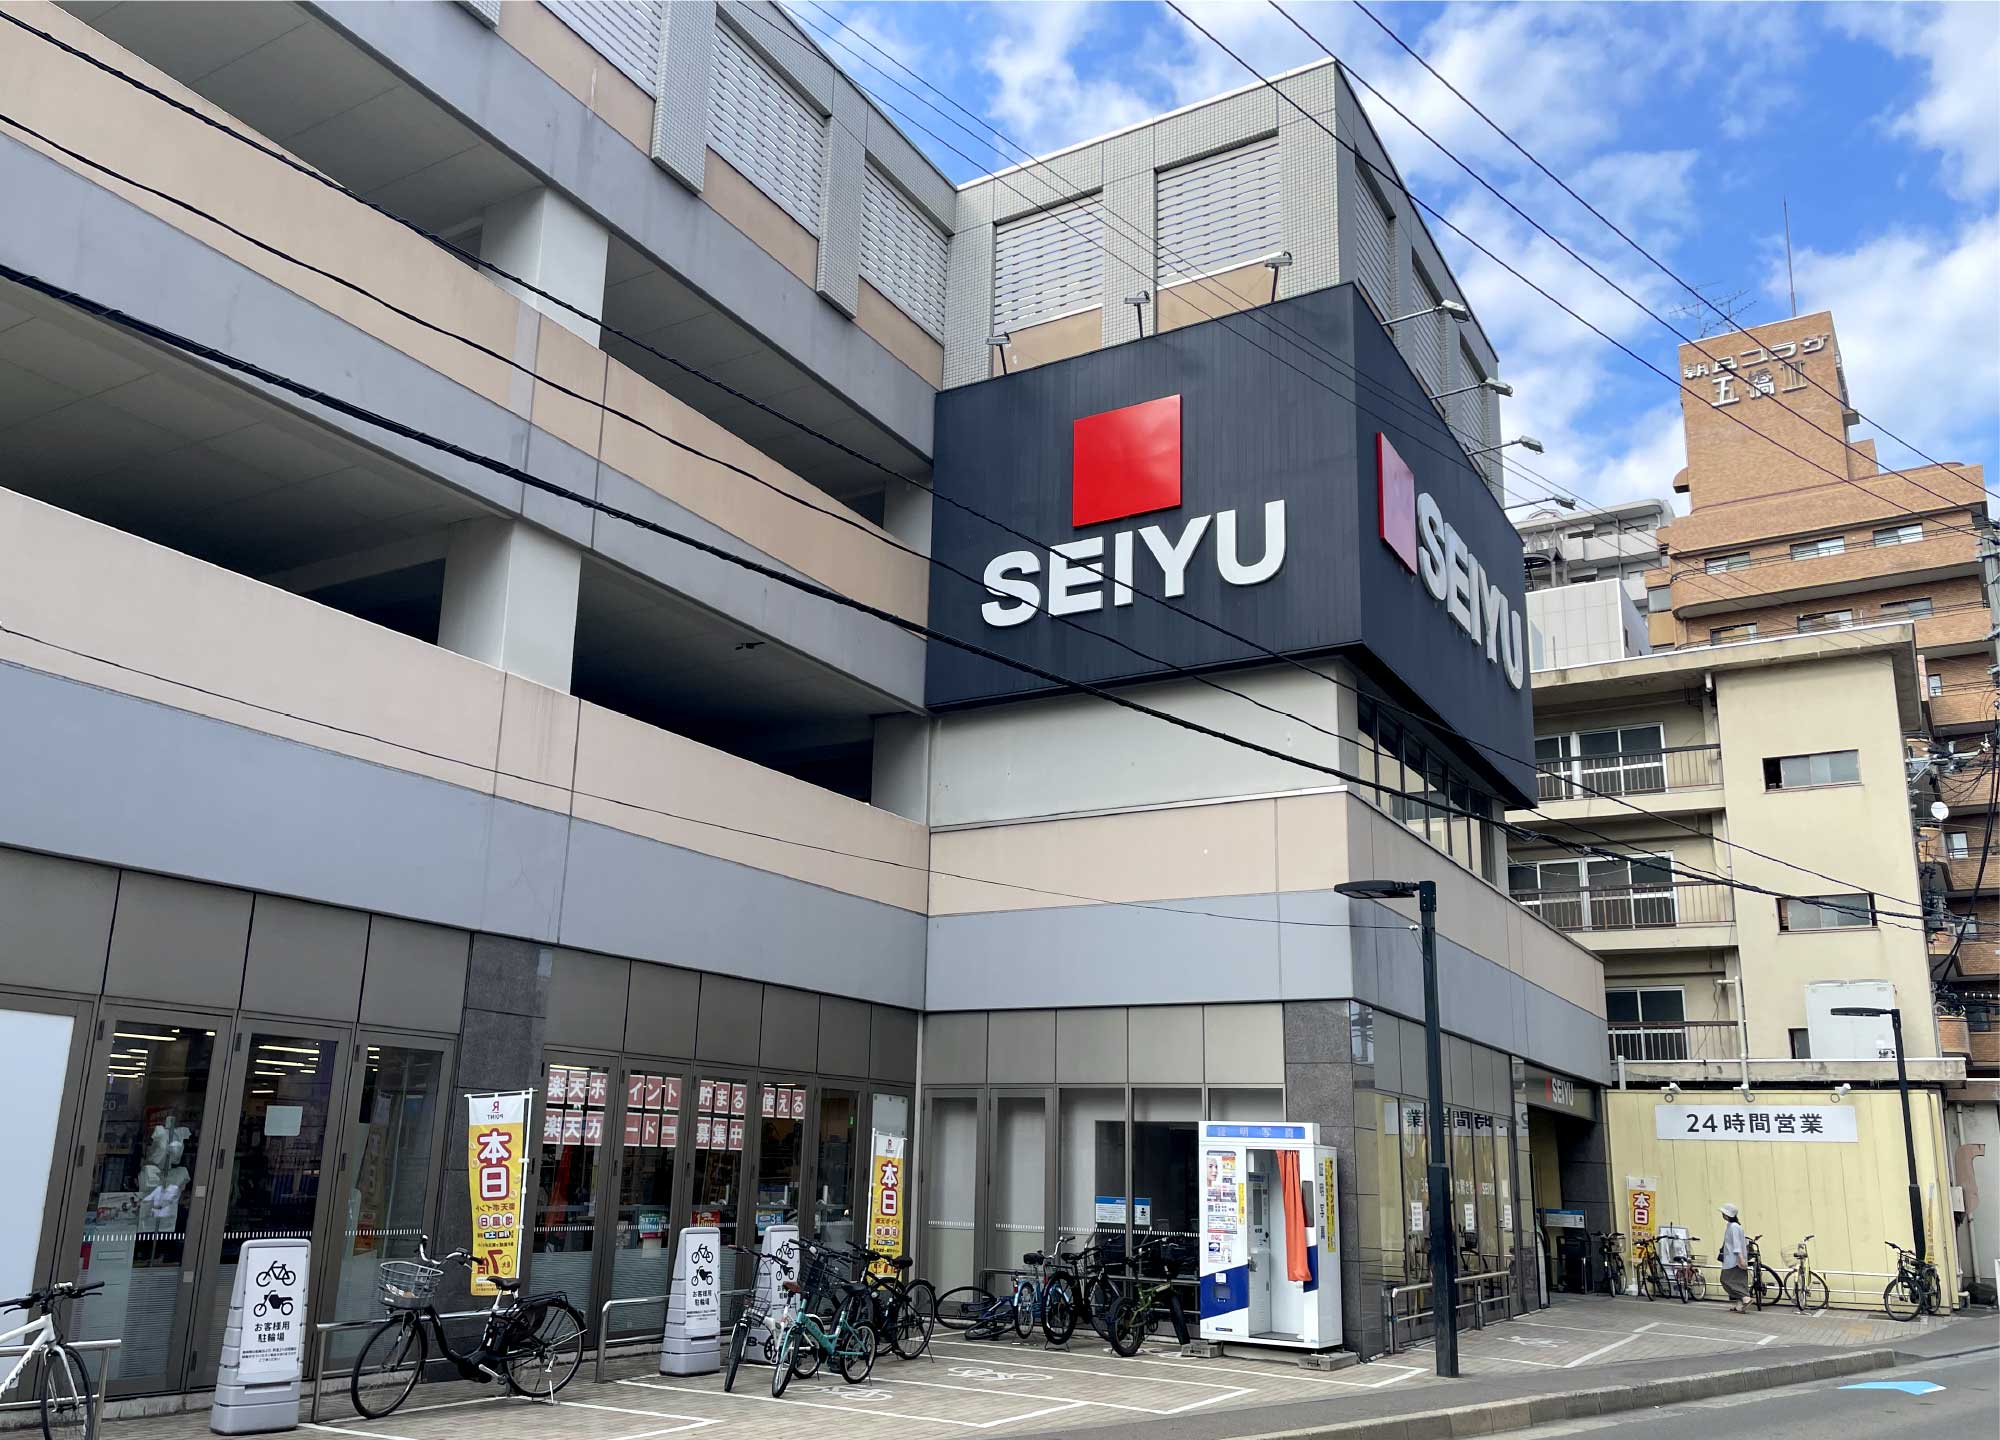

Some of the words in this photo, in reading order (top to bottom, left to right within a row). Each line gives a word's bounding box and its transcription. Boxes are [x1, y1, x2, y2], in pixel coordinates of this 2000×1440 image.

[980, 498, 1287, 628] SEIYU
[1417, 492, 1524, 691] SEIYU
[1552, 1077, 1574, 1107] SEIYU
[1686, 1112, 1824, 1134] 24時間営業
[881, 1161, 898, 1216] 本日
[1633, 1192, 1650, 1225] 本日
[254, 1321, 290, 1332] お客様用
[257, 1332, 285, 1342] 駐輪場
